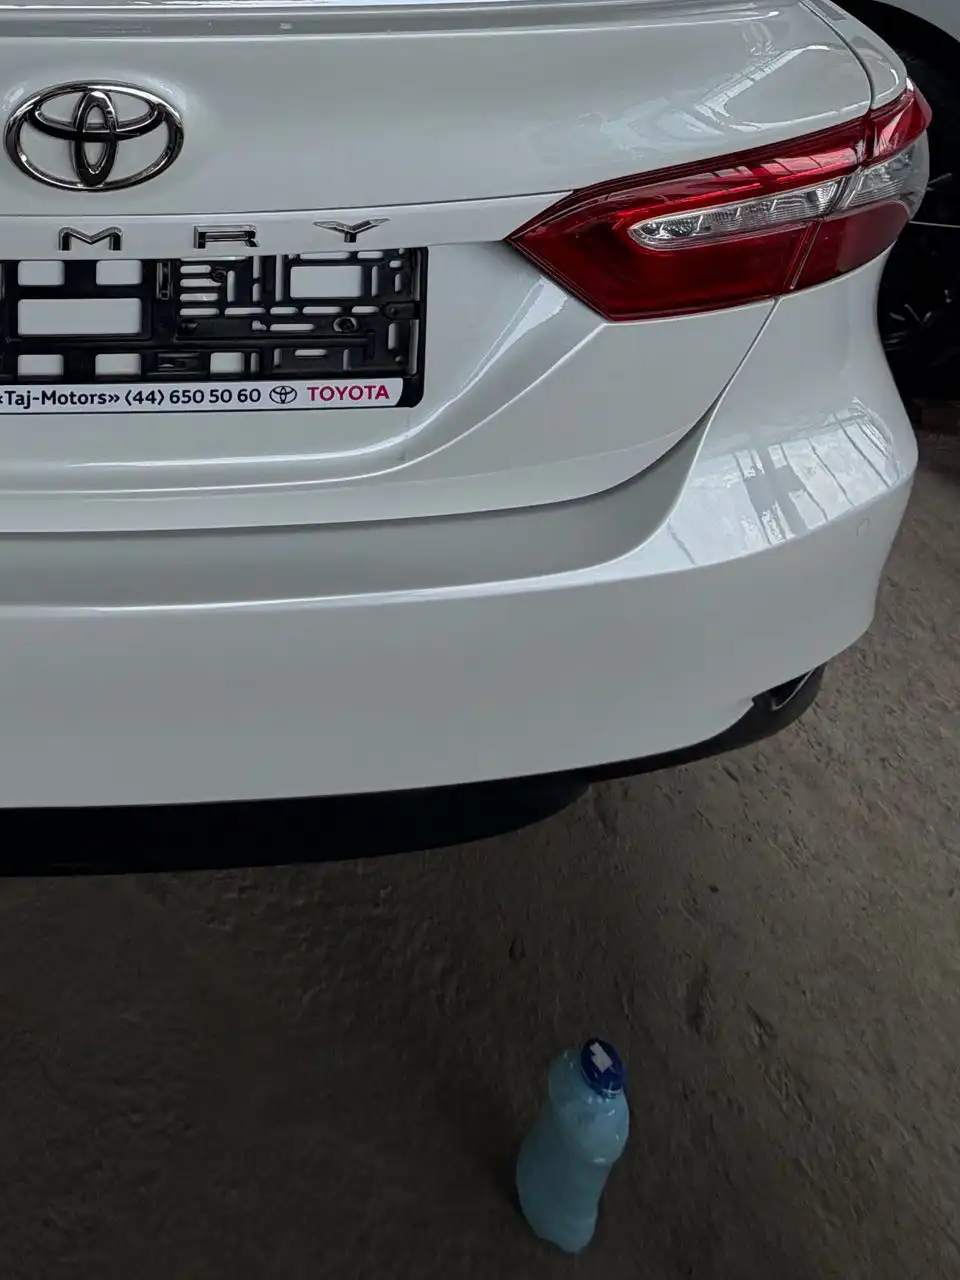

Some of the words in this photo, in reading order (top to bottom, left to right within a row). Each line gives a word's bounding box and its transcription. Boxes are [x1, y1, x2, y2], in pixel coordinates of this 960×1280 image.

[124, 388, 165, 406] (44)
[169, 389, 204, 404] 650
[208, 388, 233, 404] 50
[237, 387, 261, 403] 60
[306, 384, 390, 401] TOYOTA
